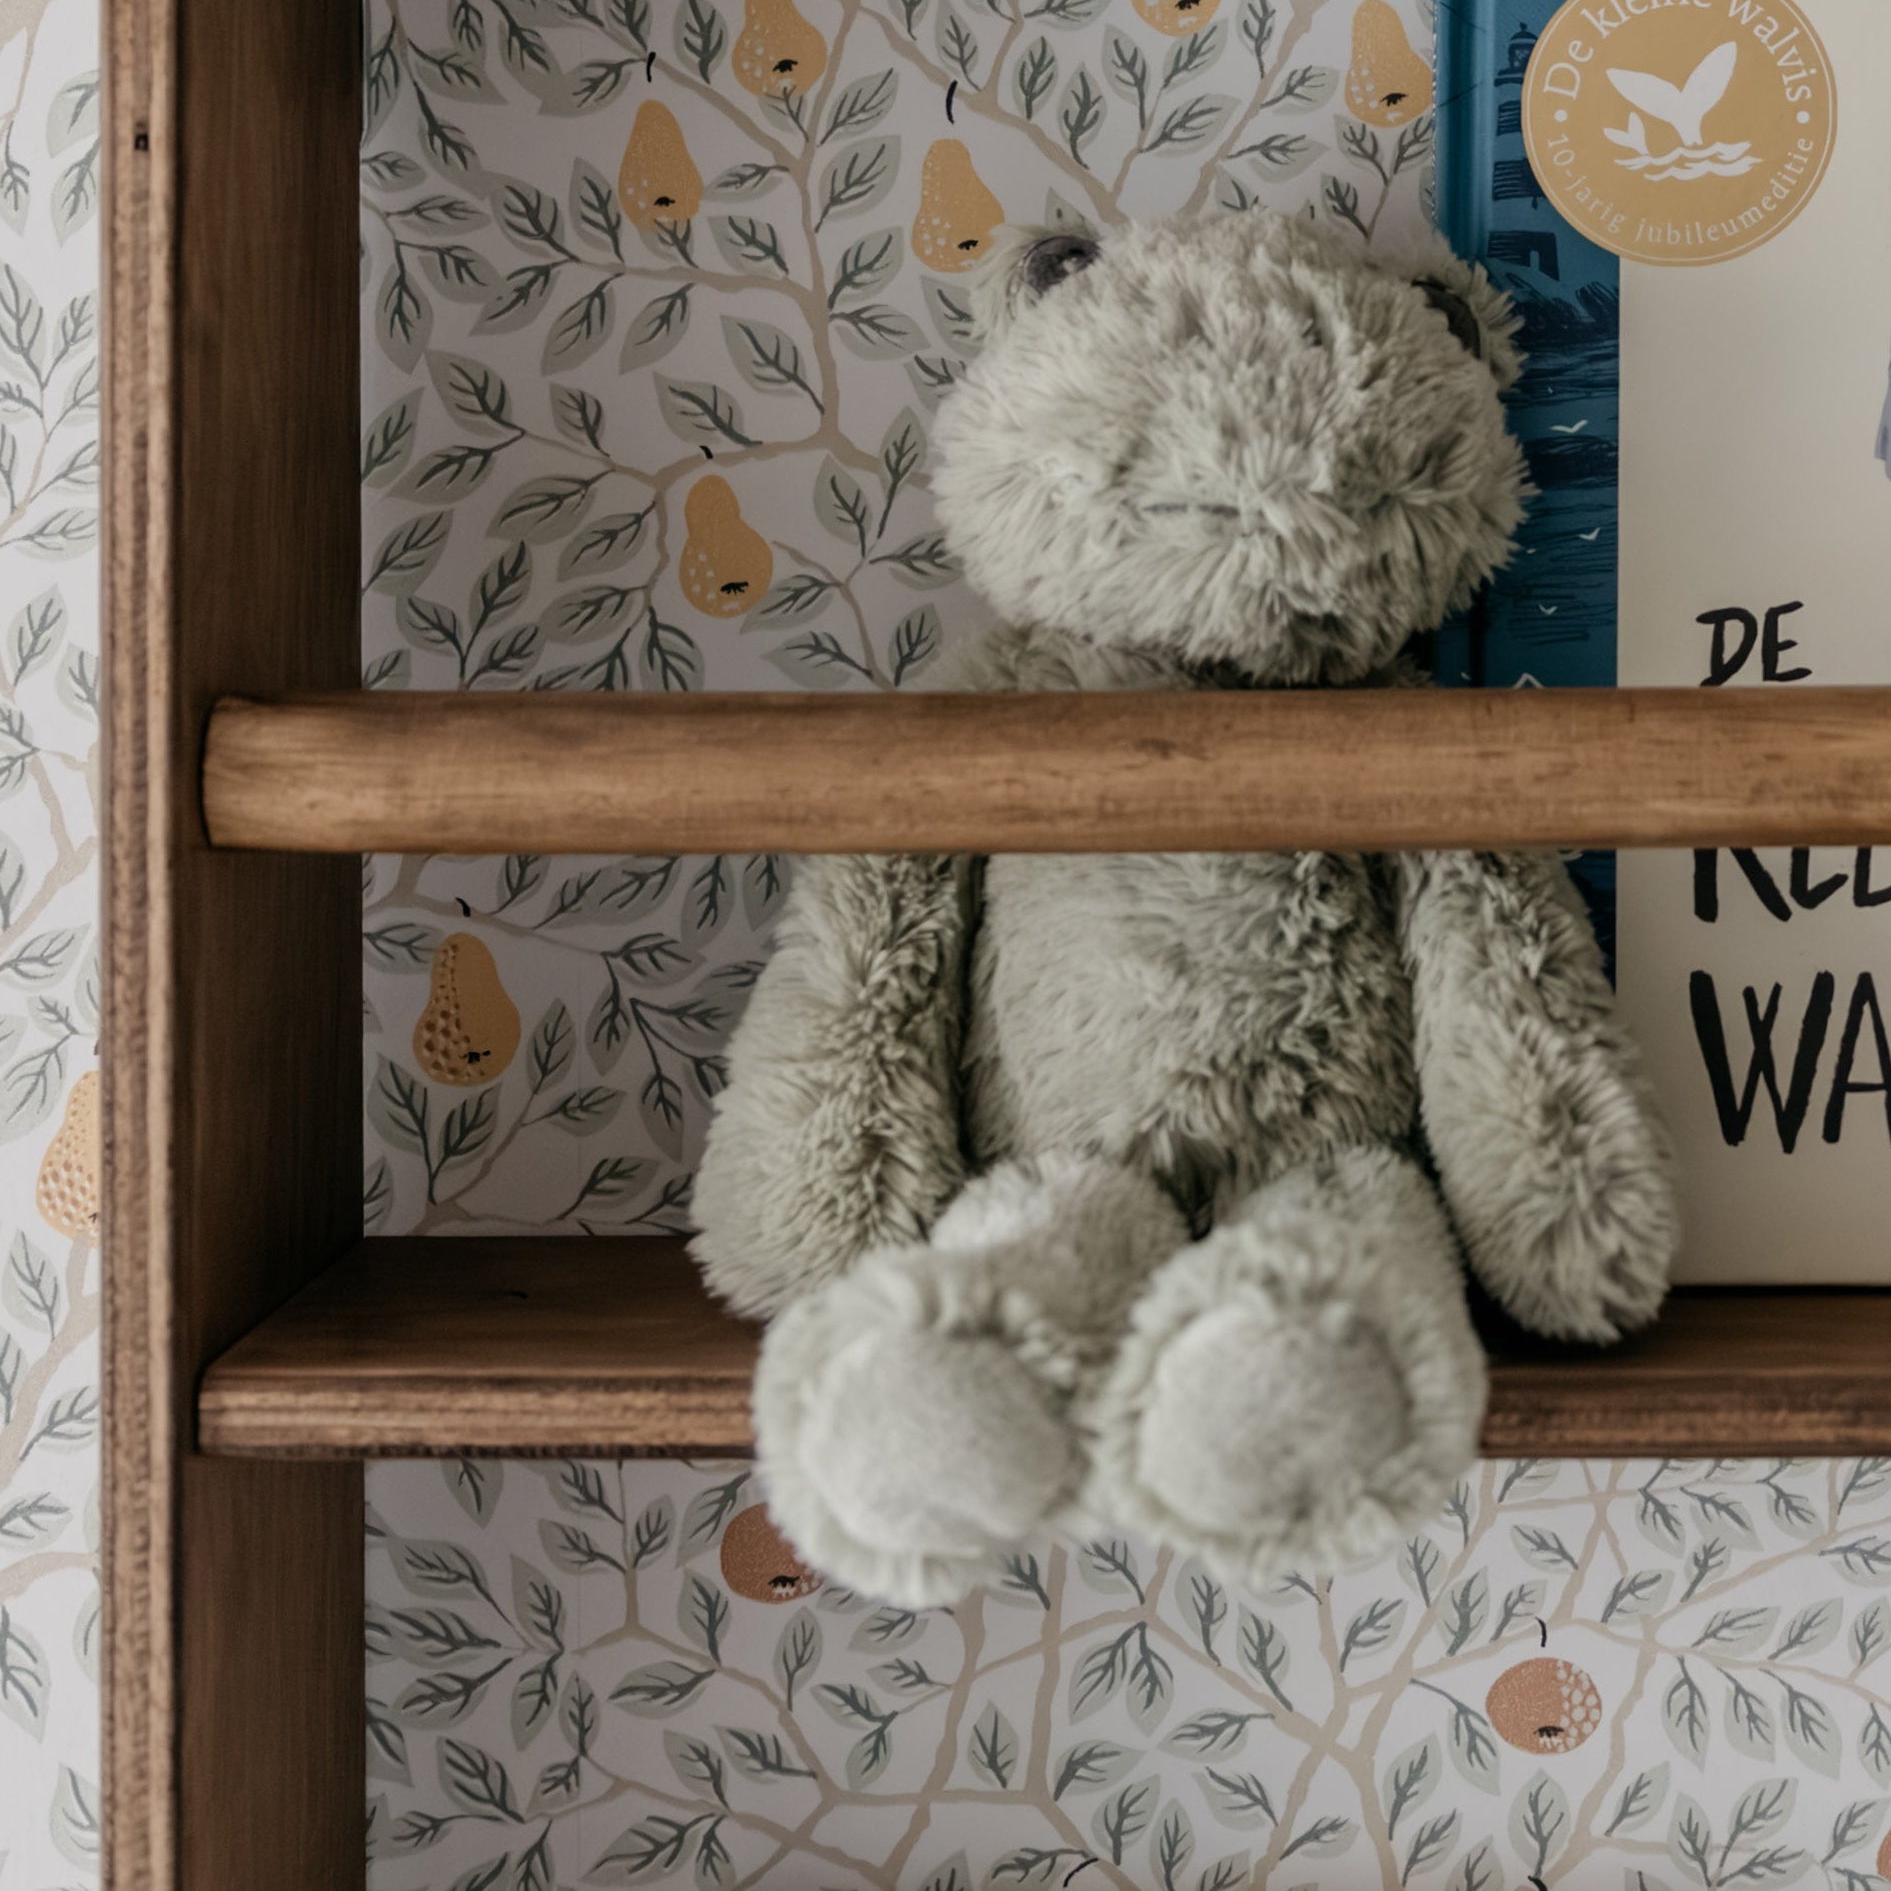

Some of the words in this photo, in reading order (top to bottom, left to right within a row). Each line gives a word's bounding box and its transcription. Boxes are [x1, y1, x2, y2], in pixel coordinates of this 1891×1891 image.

[1542, 36, 1595, 101] De
[1547, 132, 1628, 234] 10-jarig
[1633, 137, 1815, 246] jubileumeditie
[1695, 600, 1813, 686] DE
